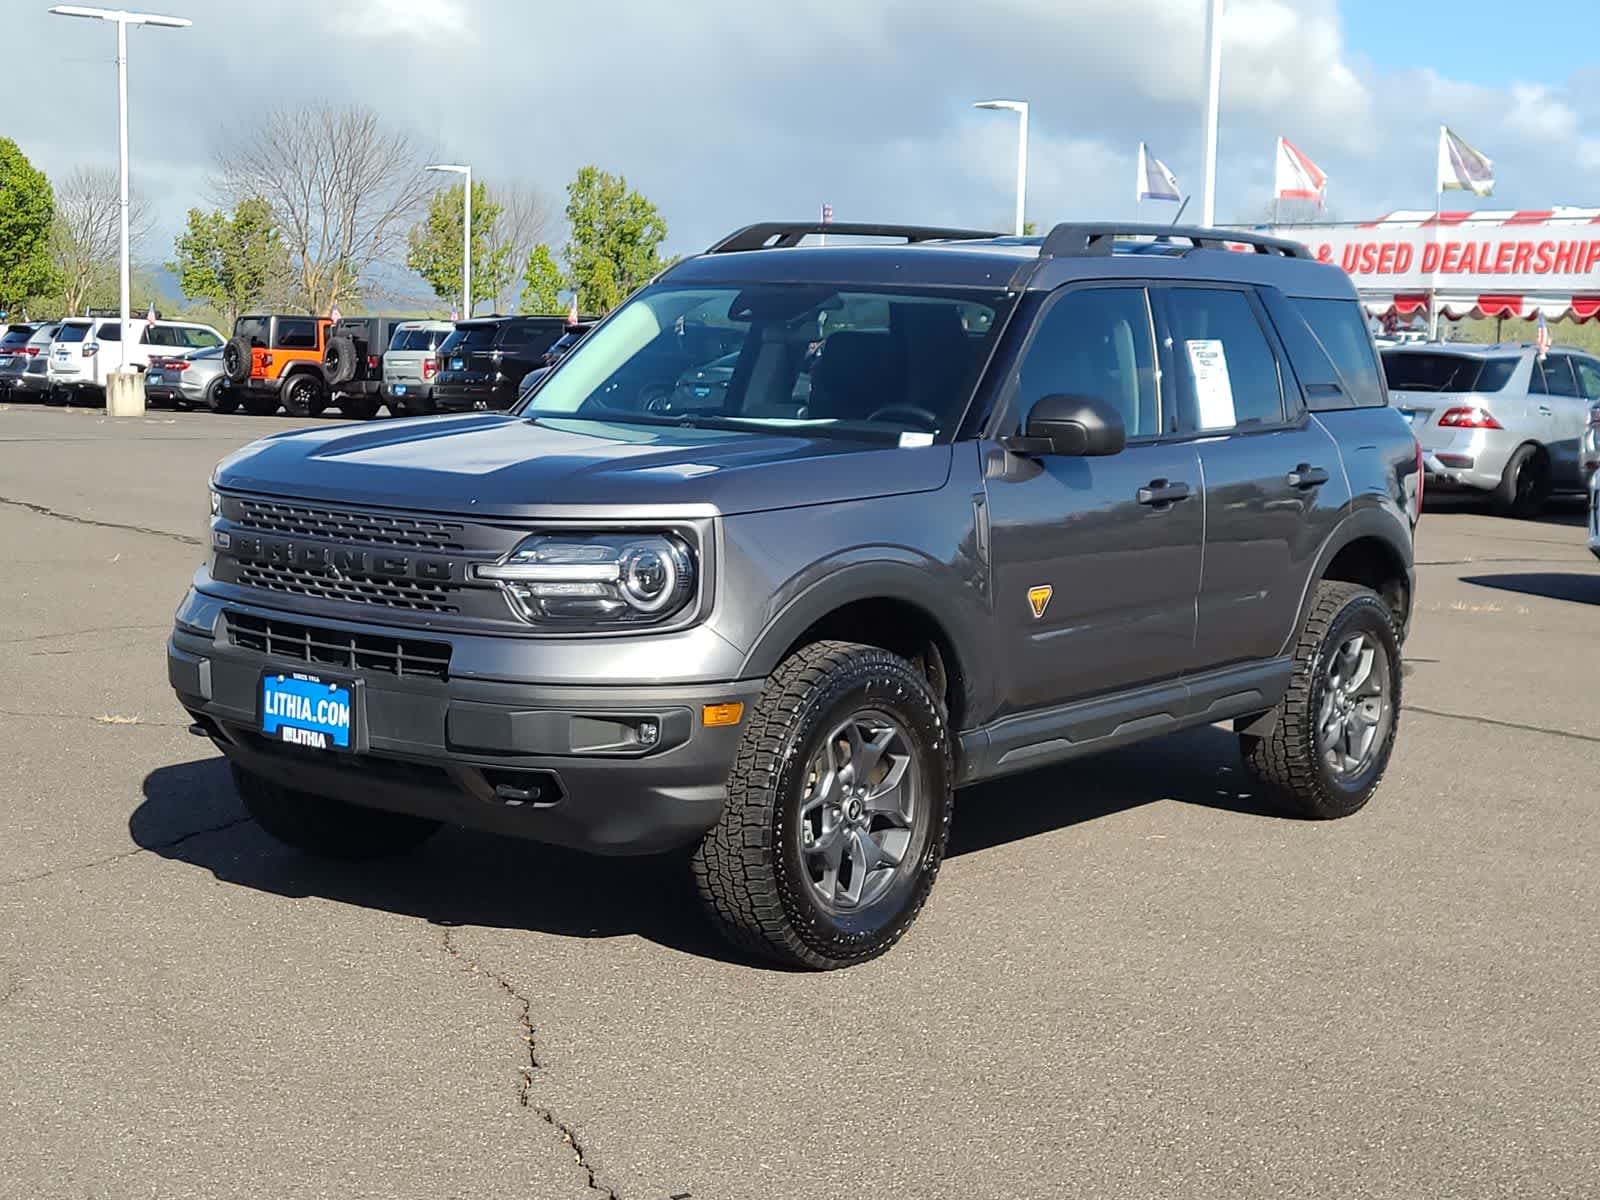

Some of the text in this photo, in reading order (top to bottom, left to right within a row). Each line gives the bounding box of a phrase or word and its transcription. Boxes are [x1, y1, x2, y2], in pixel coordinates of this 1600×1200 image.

[1317, 240, 1600, 274] & USED DEALERSHIP
[238, 537, 454, 582] BRONCO
[265, 690, 350, 728] LITHIA.COM
